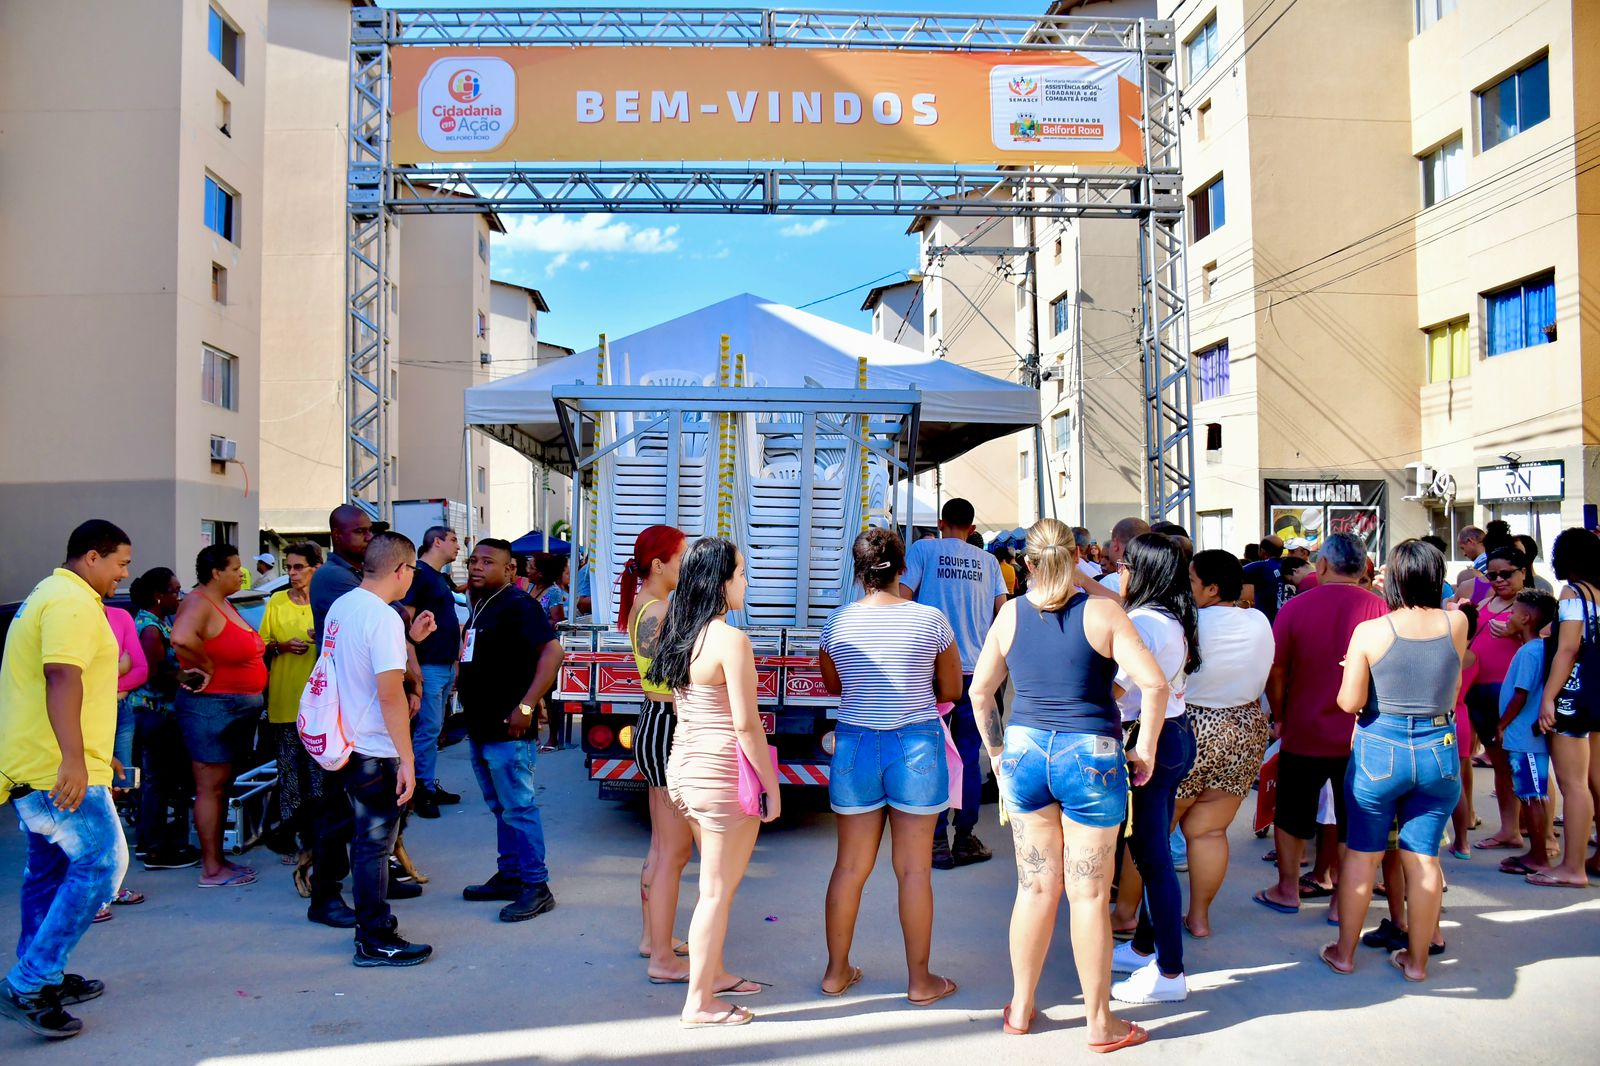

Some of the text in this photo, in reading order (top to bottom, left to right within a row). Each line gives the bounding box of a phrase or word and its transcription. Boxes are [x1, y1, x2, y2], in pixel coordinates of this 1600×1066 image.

[432, 105, 502, 117] Cidadania
[575, 89, 939, 126] BEM-VINDOS
[458, 117, 501, 135] Ação
[1042, 125, 1101, 135] Belford Roxo
[1289, 484, 1361, 502] TATUARIA
[939, 555, 982, 570] EQUIPE DE
[937, 568, 983, 582] MONTAGEM
